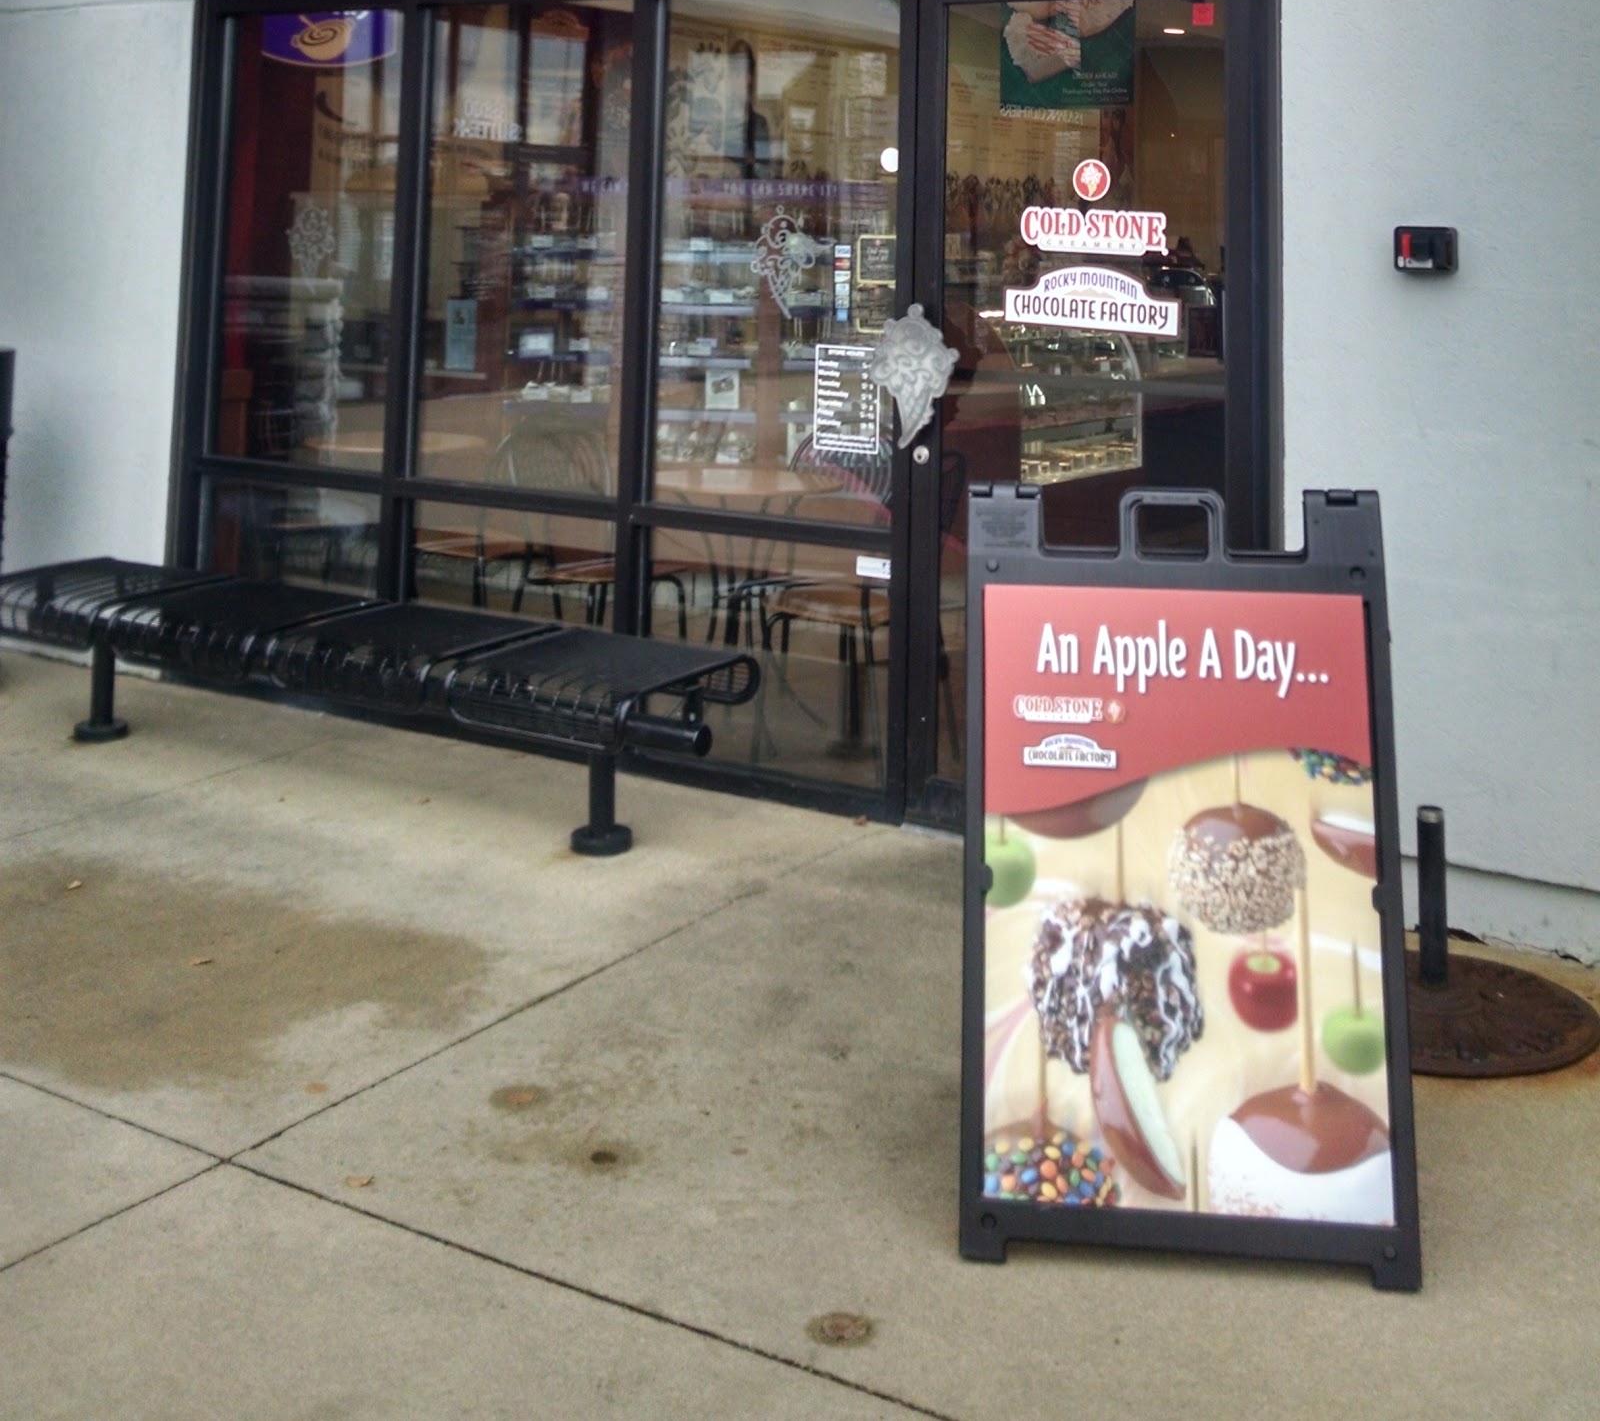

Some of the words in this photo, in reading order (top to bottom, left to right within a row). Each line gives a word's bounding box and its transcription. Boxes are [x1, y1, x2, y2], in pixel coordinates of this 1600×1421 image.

[1024, 210, 1081, 240] COLD
[1087, 213, 1162, 247] STONE
[1046, 240, 1136, 250] CREAMERY
[1044, 272, 1077, 293] ROCKY
[1080, 271, 1138, 300] MOUNTAIN
[1013, 294, 1096, 320] CHOCOLATE
[1100, 301, 1169, 330] FACTORY
[1037, 623, 1079, 675] An
[1093, 619, 1187, 693] Apple
[1199, 628, 1222, 680] A
[1234, 629, 1330, 699] Day...
[1054, 698, 1101, 718] STONE
[1028, 749, 1073, 762] CHOCOLATE
[1075, 752, 1112, 767] FACTORY
